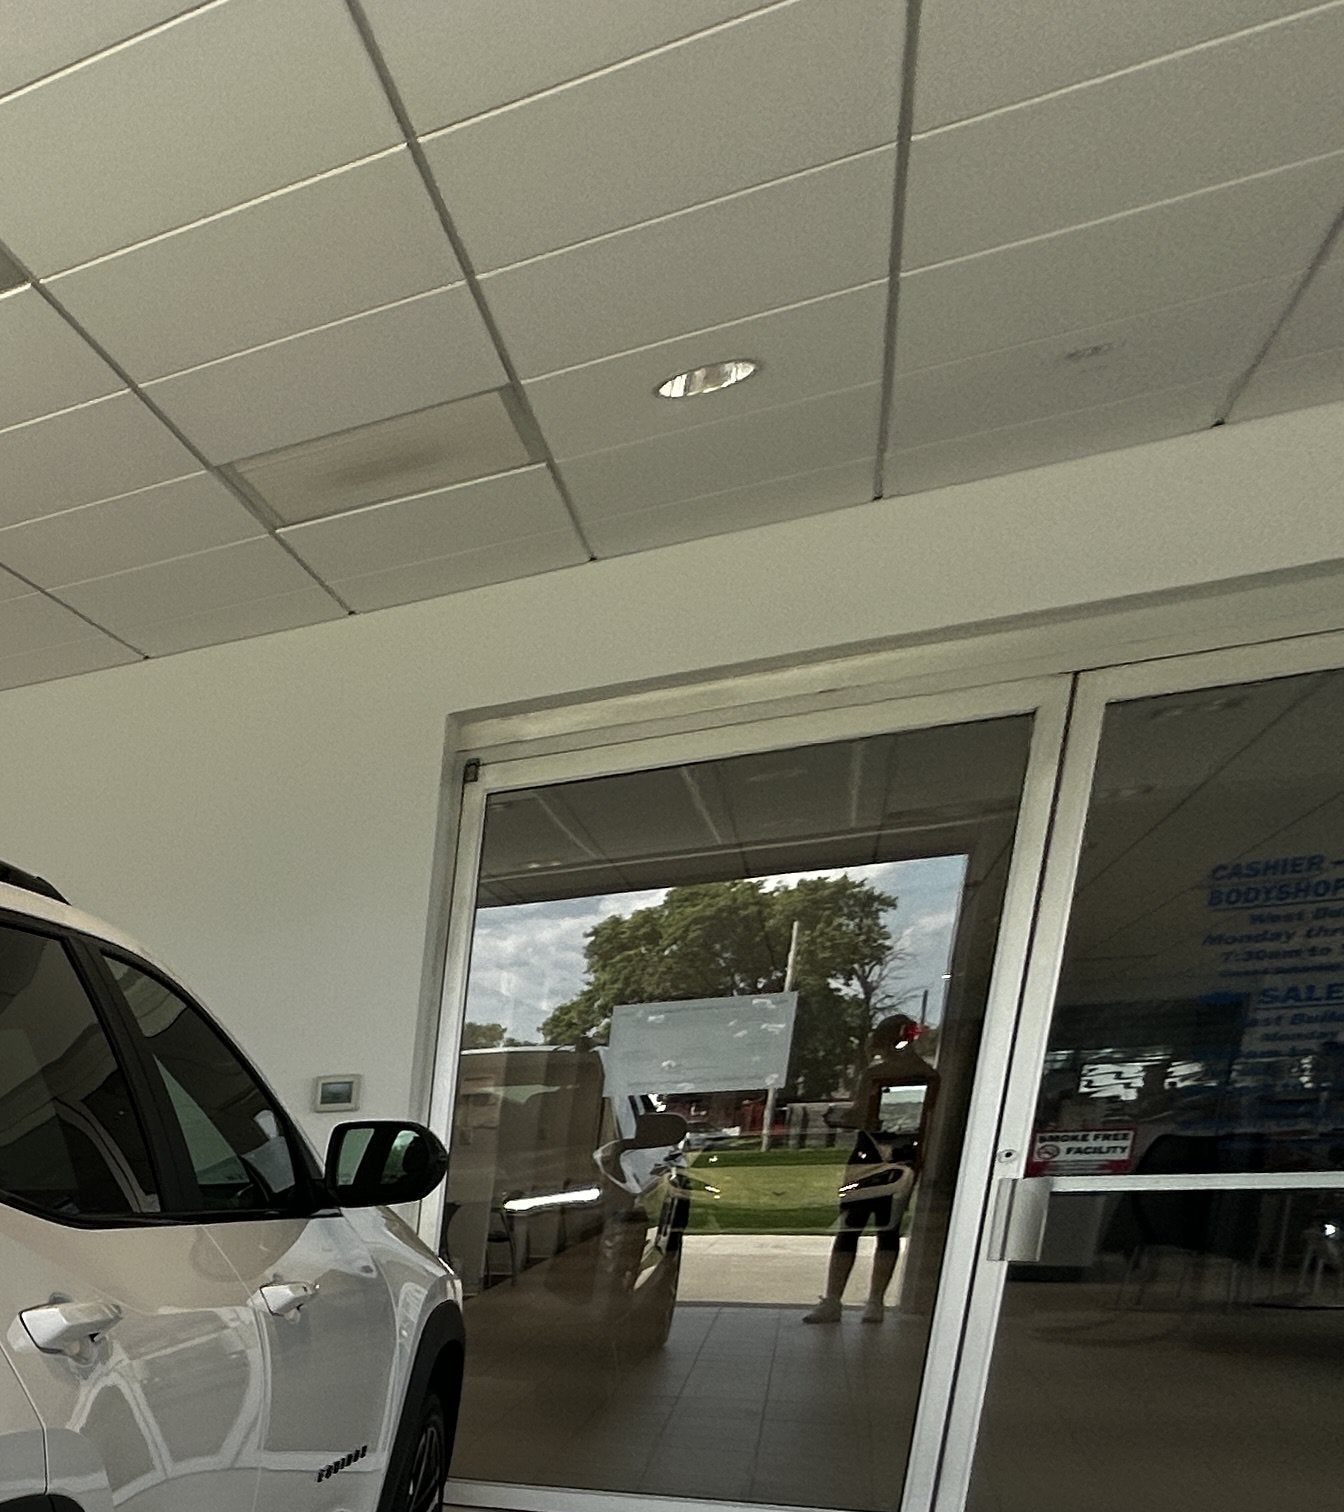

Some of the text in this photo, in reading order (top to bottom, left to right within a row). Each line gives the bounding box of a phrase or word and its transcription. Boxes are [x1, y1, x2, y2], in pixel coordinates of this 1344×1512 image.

[1210, 854, 1325, 881] CASHIER
[1038, 1132, 1130, 1144] SMOKE FREE
[1065, 1146, 1129, 1155] FACILITY
